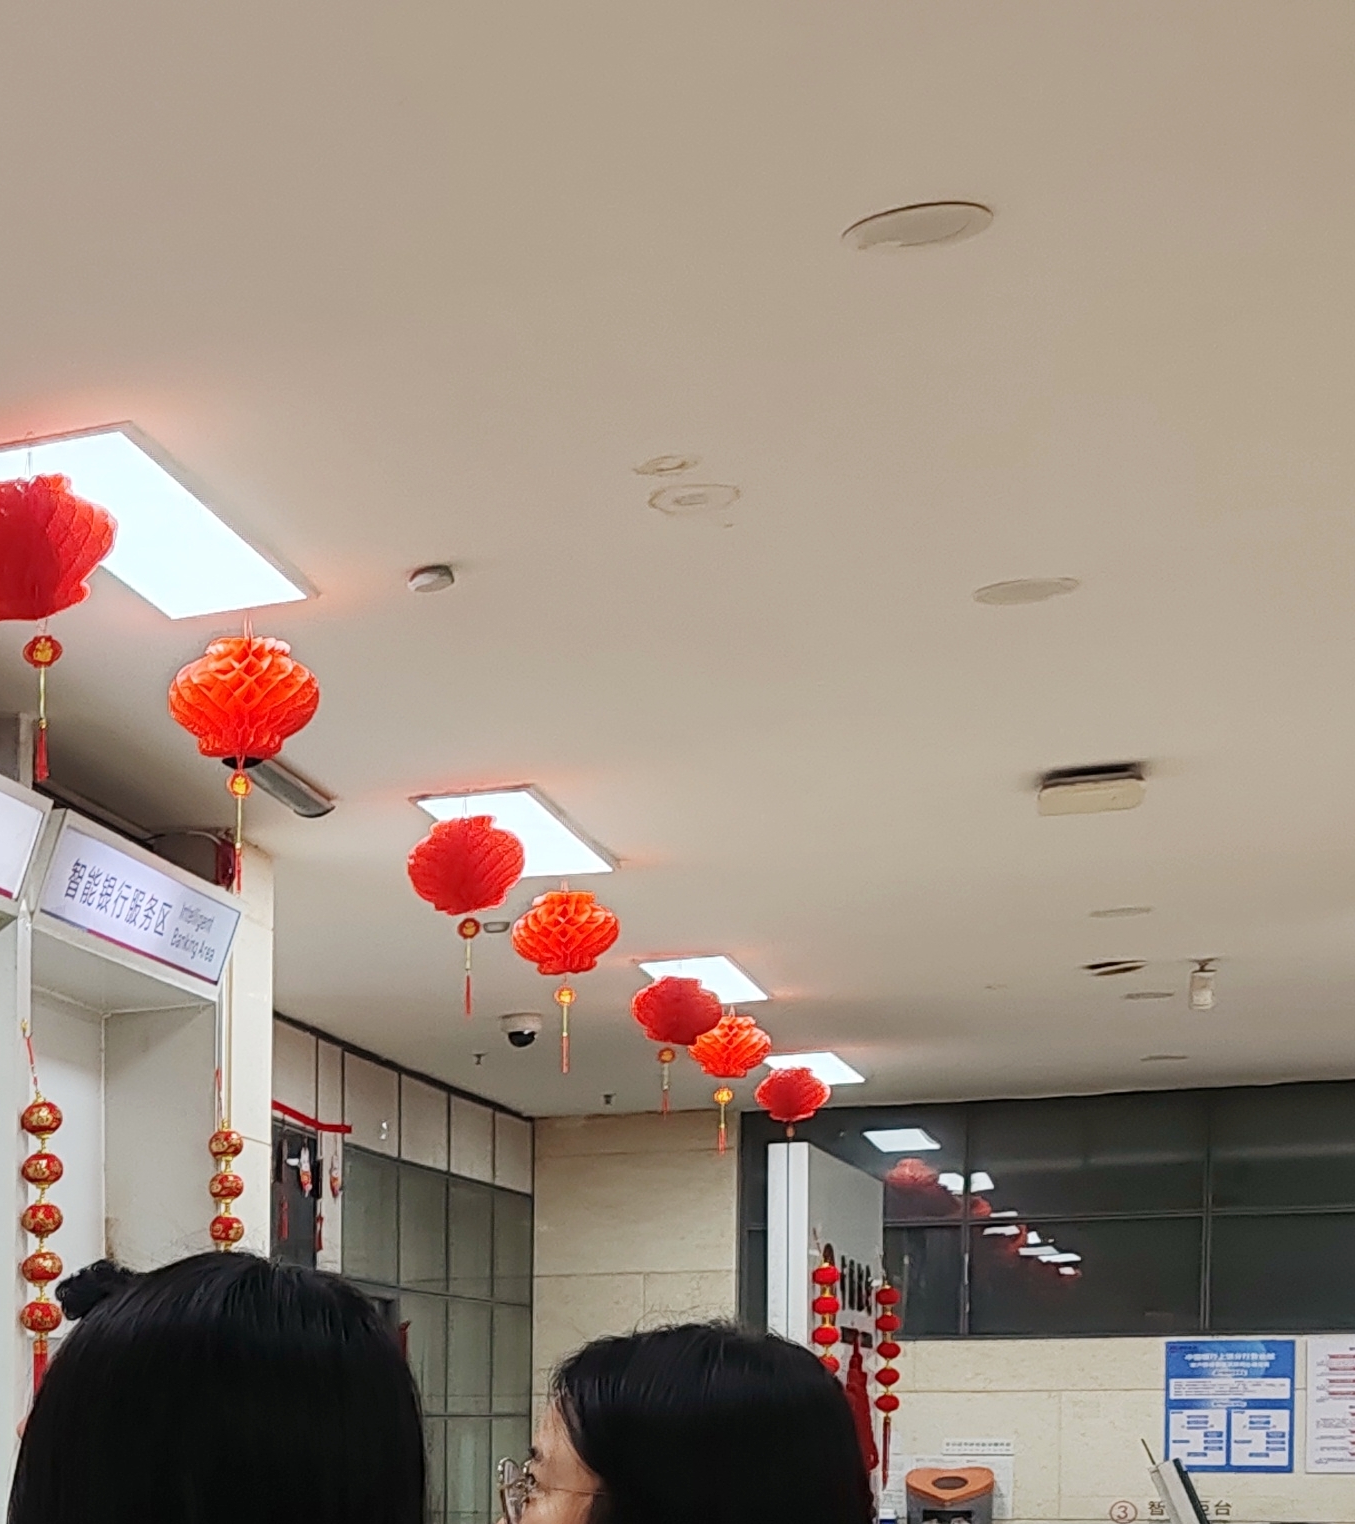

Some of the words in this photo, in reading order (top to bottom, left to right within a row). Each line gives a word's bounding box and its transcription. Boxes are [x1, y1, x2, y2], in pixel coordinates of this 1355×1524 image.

[65, 858, 172, 936] 智能银行服务区
